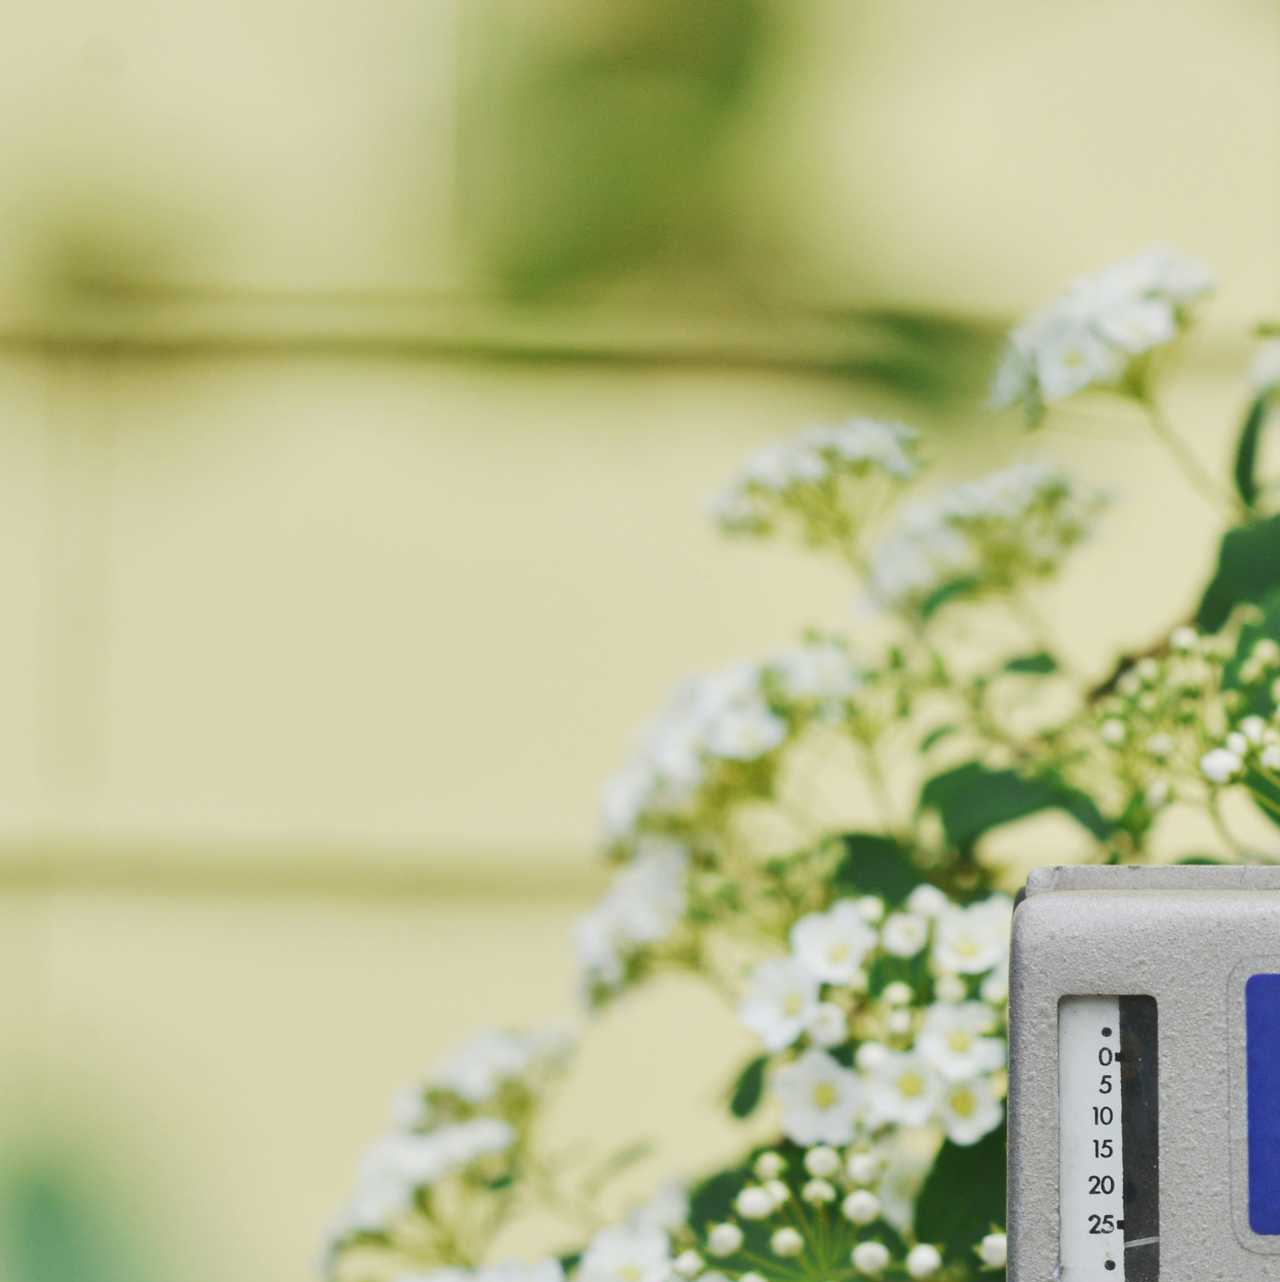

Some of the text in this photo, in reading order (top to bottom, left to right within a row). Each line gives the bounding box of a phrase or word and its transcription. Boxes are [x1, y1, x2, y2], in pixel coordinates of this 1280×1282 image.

[1098, 1047, 1113, 1066] 0
[1098, 1075, 1113, 1094] 5
[1092, 1106, 1114, 1126] 10
[1092, 1139, 1114, 1159] 15
[1088, 1175, 1115, 1195] 20
[1087, 1214, 1115, 1234] 25
